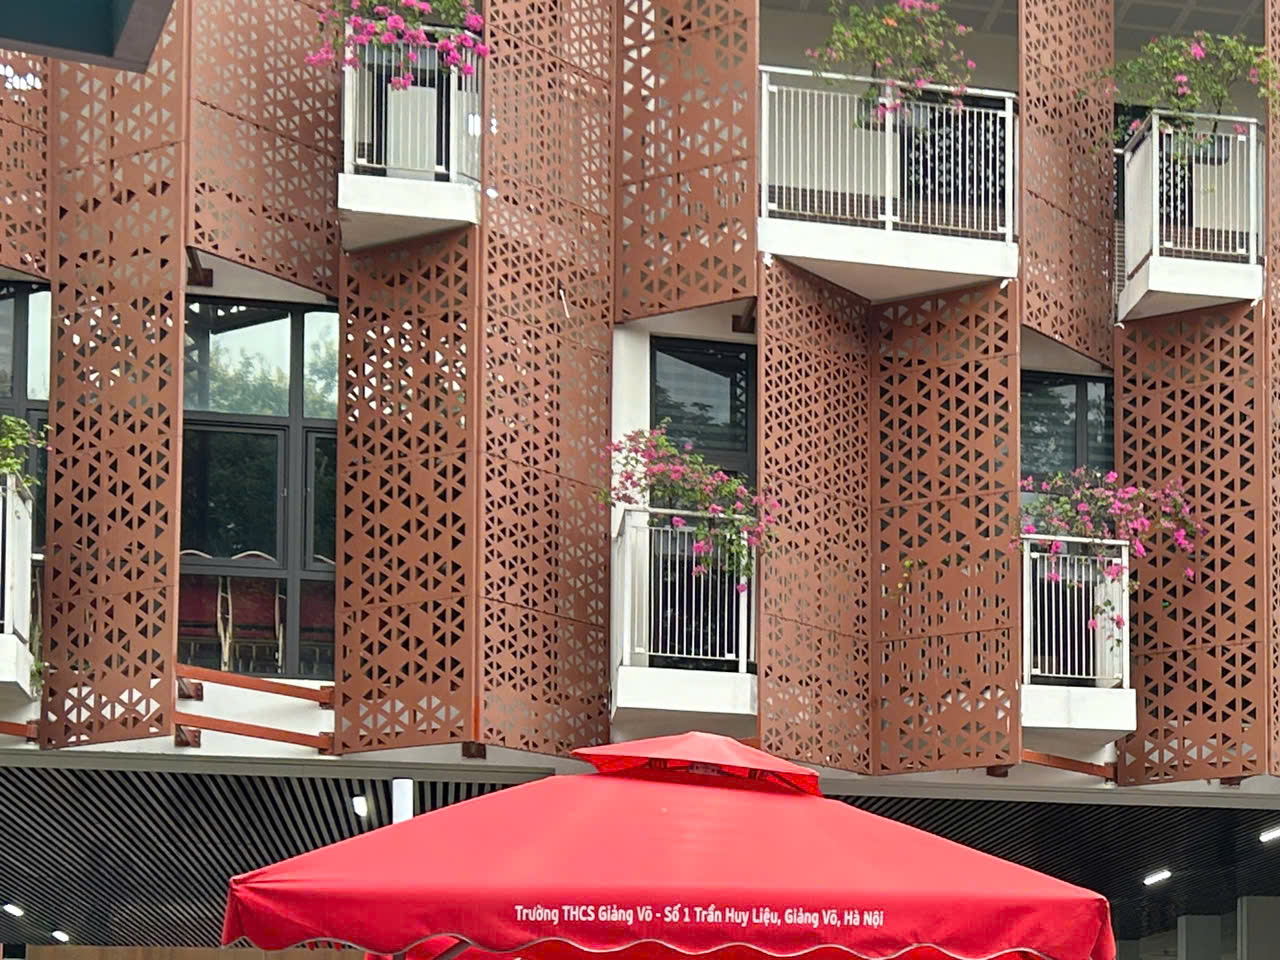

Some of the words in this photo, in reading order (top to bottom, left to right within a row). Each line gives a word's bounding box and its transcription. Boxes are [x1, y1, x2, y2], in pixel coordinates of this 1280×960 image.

[515, 905, 559, 925] Trường
[562, 905, 596, 922] THCS
[598, 904, 634, 925] Giảng
[636, 906, 653, 921] Võ
[663, 904, 682, 922] Số
[683, 908, 691, 922] 1
[725, 908, 750, 927] Huy
[752, 908, 782, 926] Liệu,
[784, 908, 819, 928] Giảng
[822, 909, 841, 928] Võ,
[844, 909, 860, 926] Hà
[863, 910, 885, 928] Nội
